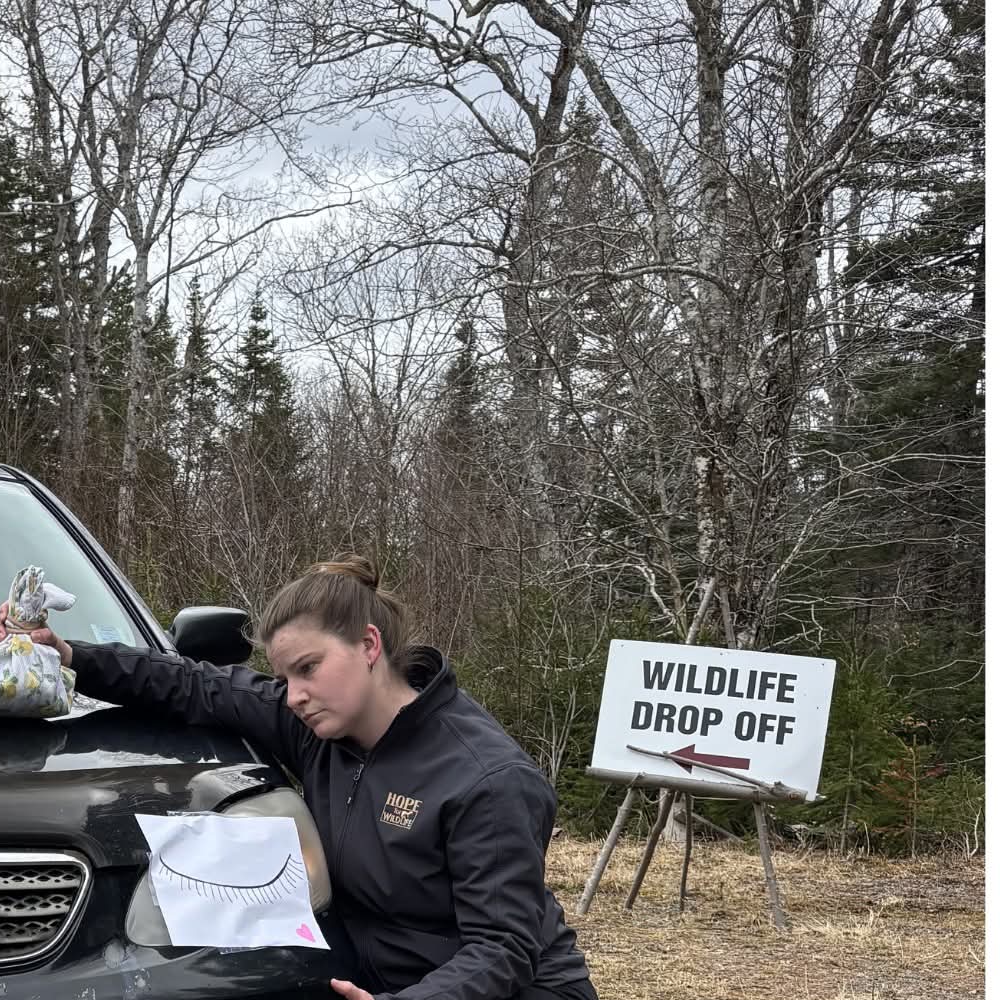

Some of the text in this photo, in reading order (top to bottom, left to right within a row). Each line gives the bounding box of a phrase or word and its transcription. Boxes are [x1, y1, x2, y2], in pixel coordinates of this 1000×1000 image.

[643, 660, 797, 703] WILDLIFE
[631, 700, 796, 745] DROP OFF
[386, 792, 423, 812] HOPE
